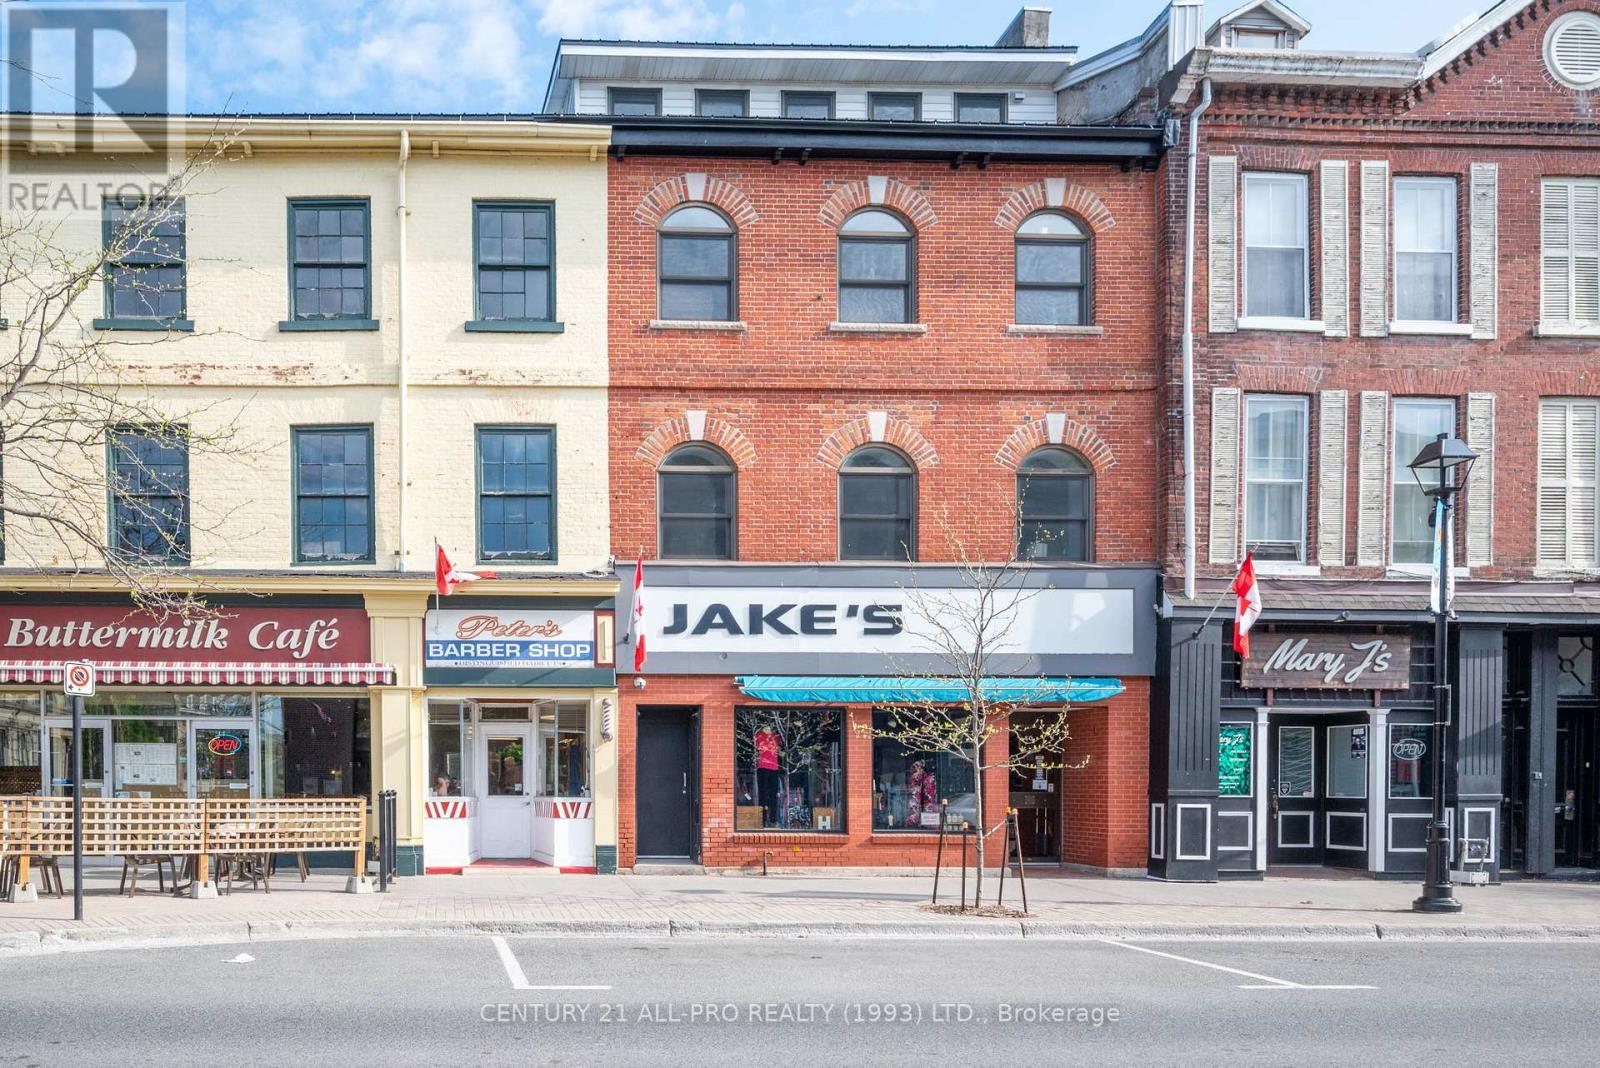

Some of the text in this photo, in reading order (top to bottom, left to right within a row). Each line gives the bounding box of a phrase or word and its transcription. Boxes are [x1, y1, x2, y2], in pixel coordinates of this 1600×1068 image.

[456, 615, 562, 640] Peter's
[663, 603, 903, 635] JAKE'S
[4, 618, 340, 659] Buttermilk Café
[428, 643, 590, 657] BARBER SHOP
[1263, 638, 1393, 683] Mary J's
[212, 738, 239, 751] OPEN
[1394, 743, 1424, 755] OPEN
